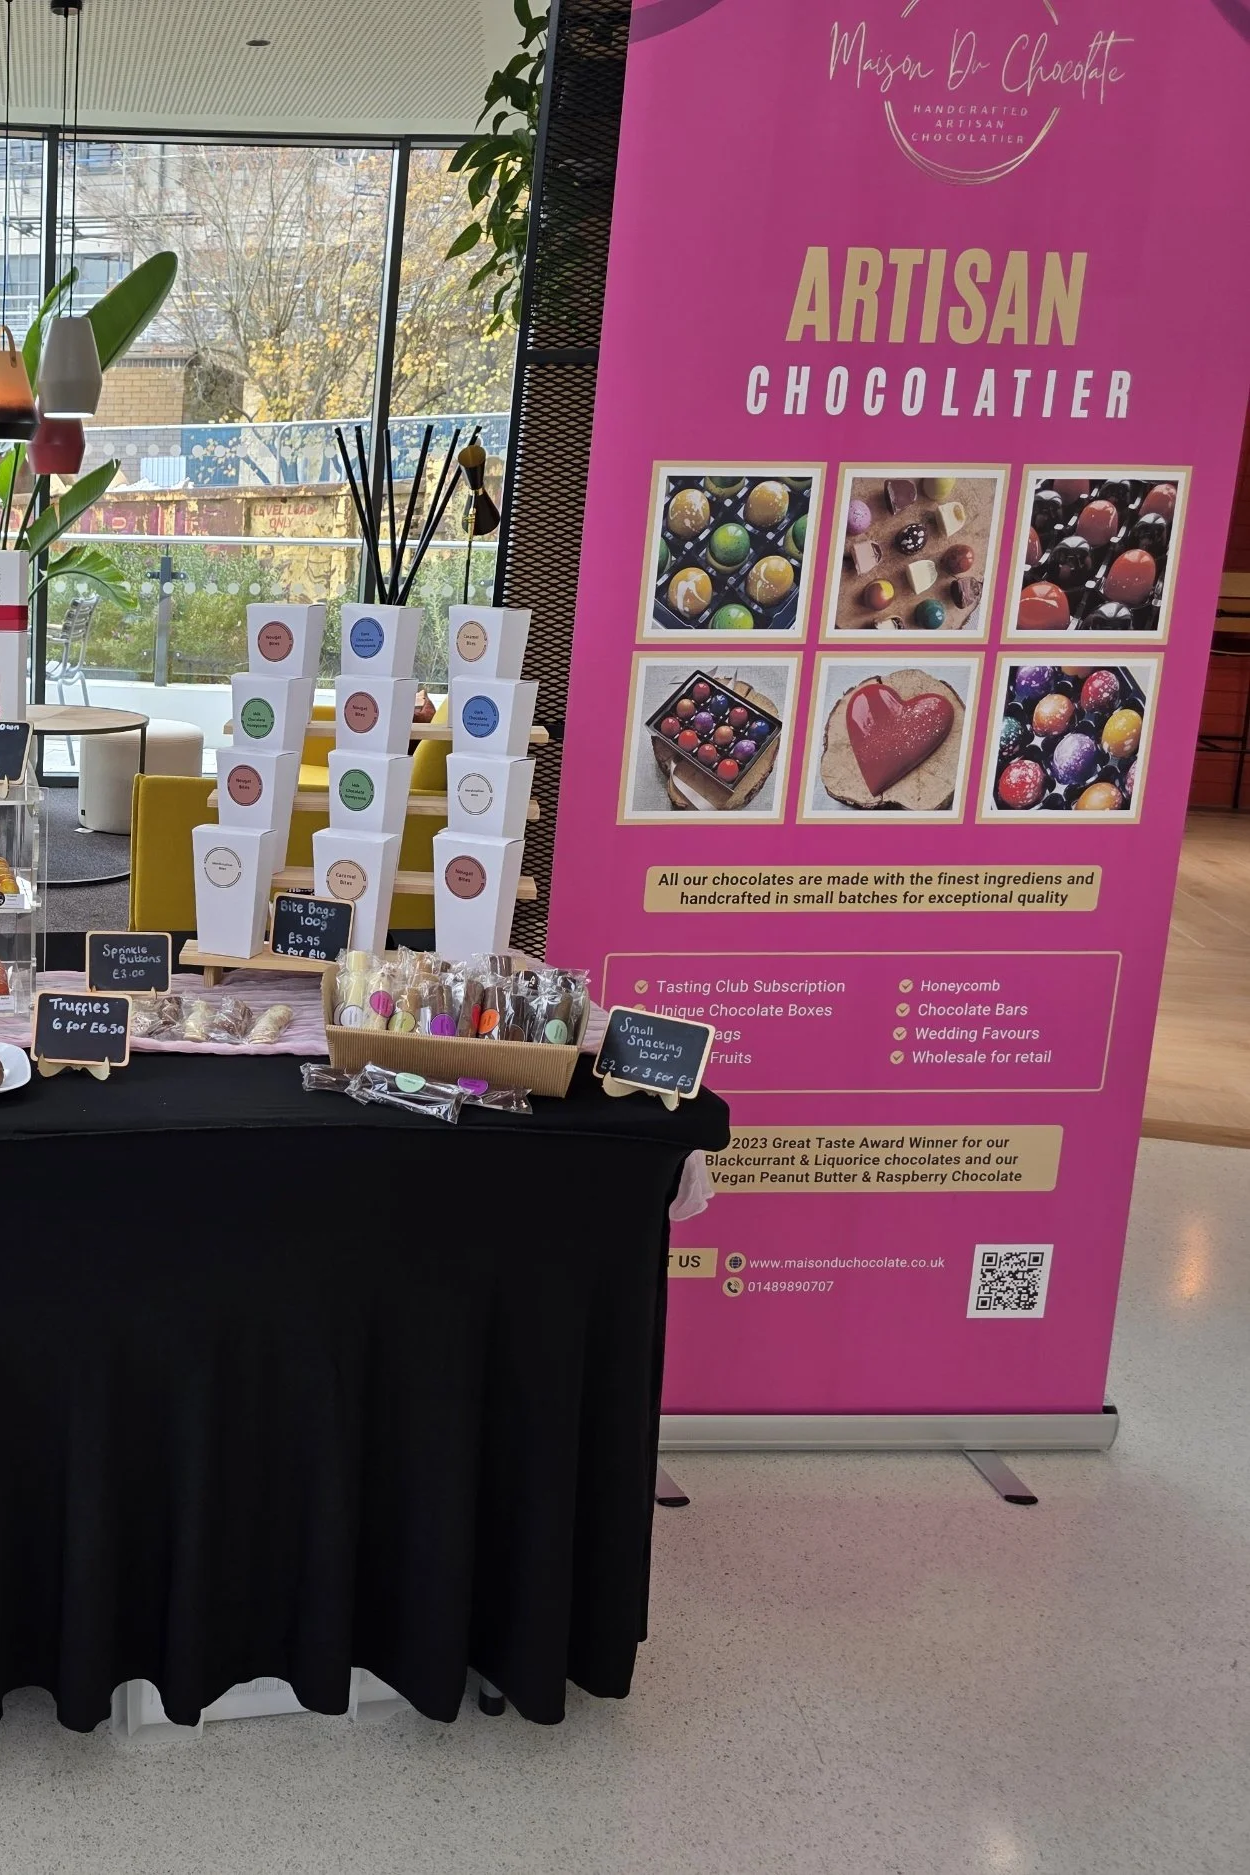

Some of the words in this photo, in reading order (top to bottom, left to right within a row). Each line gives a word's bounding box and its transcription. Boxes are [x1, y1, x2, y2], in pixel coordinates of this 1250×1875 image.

[829, 21, 935, 93] Maison
[947, 28, 991, 90] Du
[1001, 30, 1135, 104] Chocolate
[913, 104, 1029, 117] HANDCRAFTED
[935, 119, 1005, 129] ARTISAN
[910, 132, 1025, 145] CHOCOLATIER
[785, 246, 1088, 346] ARTISAN
[746, 365, 1132, 419] CHOCOLATIER
[657, 872, 679, 886] All
[683, 875, 709, 886] our
[711, 872, 795, 886] chocolates
[798, 875, 823, 886] are
[826, 871, 869, 886] made
[873, 872, 905, 886] with
[909, 871, 933, 886] the
[937, 871, 980, 885] finest
[983, 871, 1063, 889] ingrediens
[1066, 871, 1095, 885] and
[680, 890, 771, 905] handcrafted
[775, 891, 789, 905] in
[792, 890, 834, 905] small
[838, 890, 898, 904] batches
[902, 890, 925, 904] for
[928, 890, 1014, 907] exceptional
[1017, 890, 1069, 907] quality
[280, 900, 304, 914] Bite
[308, 901, 337, 919] Bags
[300, 915, 328, 931] 100g
[288, 931, 320, 946] £5.95
[102, 943, 148, 959] Sprinkle
[119, 953, 162, 965] Buttons
[287, 947, 304, 957] for
[308, 948, 327, 960] £10
[112, 968, 146, 980] £3.00
[656, 980, 711, 996] Tasting
[715, 979, 749, 993] Club
[753, 979, 846, 996] Subscription
[920, 979, 1001, 995] Honeycomb
[49, 997, 110, 1017] Truffles
[654, 1004, 705, 1020] Unique
[709, 1003, 784, 1017] Chocolate
[788, 1003, 833, 1017] Boxes
[917, 1002, 991, 1017] Chocolate
[995, 1003, 1029, 1016] Bars
[52, 1017, 62, 1030] 6
[66, 1019, 87, 1033] for
[89, 1021, 126, 1035] £6.50
[619, 1016, 654, 1036] Small
[715, 1030, 742, 1044] ags
[915, 1026, 978, 1043] Wedding
[982, 1026, 1040, 1040] Favours
[627, 1034, 683, 1058] Snacking
[639, 1048, 670, 1061] bars
[708, 1049, 752, 1064] Fruits
[912, 1050, 987, 1064] Wholesale
[990, 1049, 1012, 1063] for
[1014, 1049, 1052, 1064] retail
[600, 1058, 616, 1071] £2
[621, 1065, 638, 1074] or
[641, 1067, 652, 1079] 3
[654, 1071, 674, 1082] for
[676, 1074, 694, 1087] £5
[731, 1137, 768, 1150] 2023
[772, 1137, 812, 1149] Great
[815, 1137, 856, 1149] Taste
[858, 1136, 905, 1149] Award
[909, 1136, 959, 1149] Winner
[962, 1135, 983, 1148] for
[986, 1138, 1010, 1148] our
[705, 1153, 796, 1167] Blackcurrant
[799, 1154, 810, 1166] &
[813, 1153, 881, 1169] Liquorice
[884, 1153, 961, 1166] chocolates
[964, 1152, 992, 1165] and
[995, 1155, 1019, 1165] our
[711, 1171, 756, 1186] Vegan
[759, 1171, 810, 1183] Peanut
[813, 1171, 858, 1183] Butter
[861, 1170, 872, 1183] &
[876, 1170, 948, 1185] Raspberry
[951, 1169, 1023, 1182] Chocolate
[678, 1255, 701, 1268] US
[749, 1256, 945, 1269] www.maisonduchocolate.co.uk
[747, 1280, 834, 1293] 01489890707
